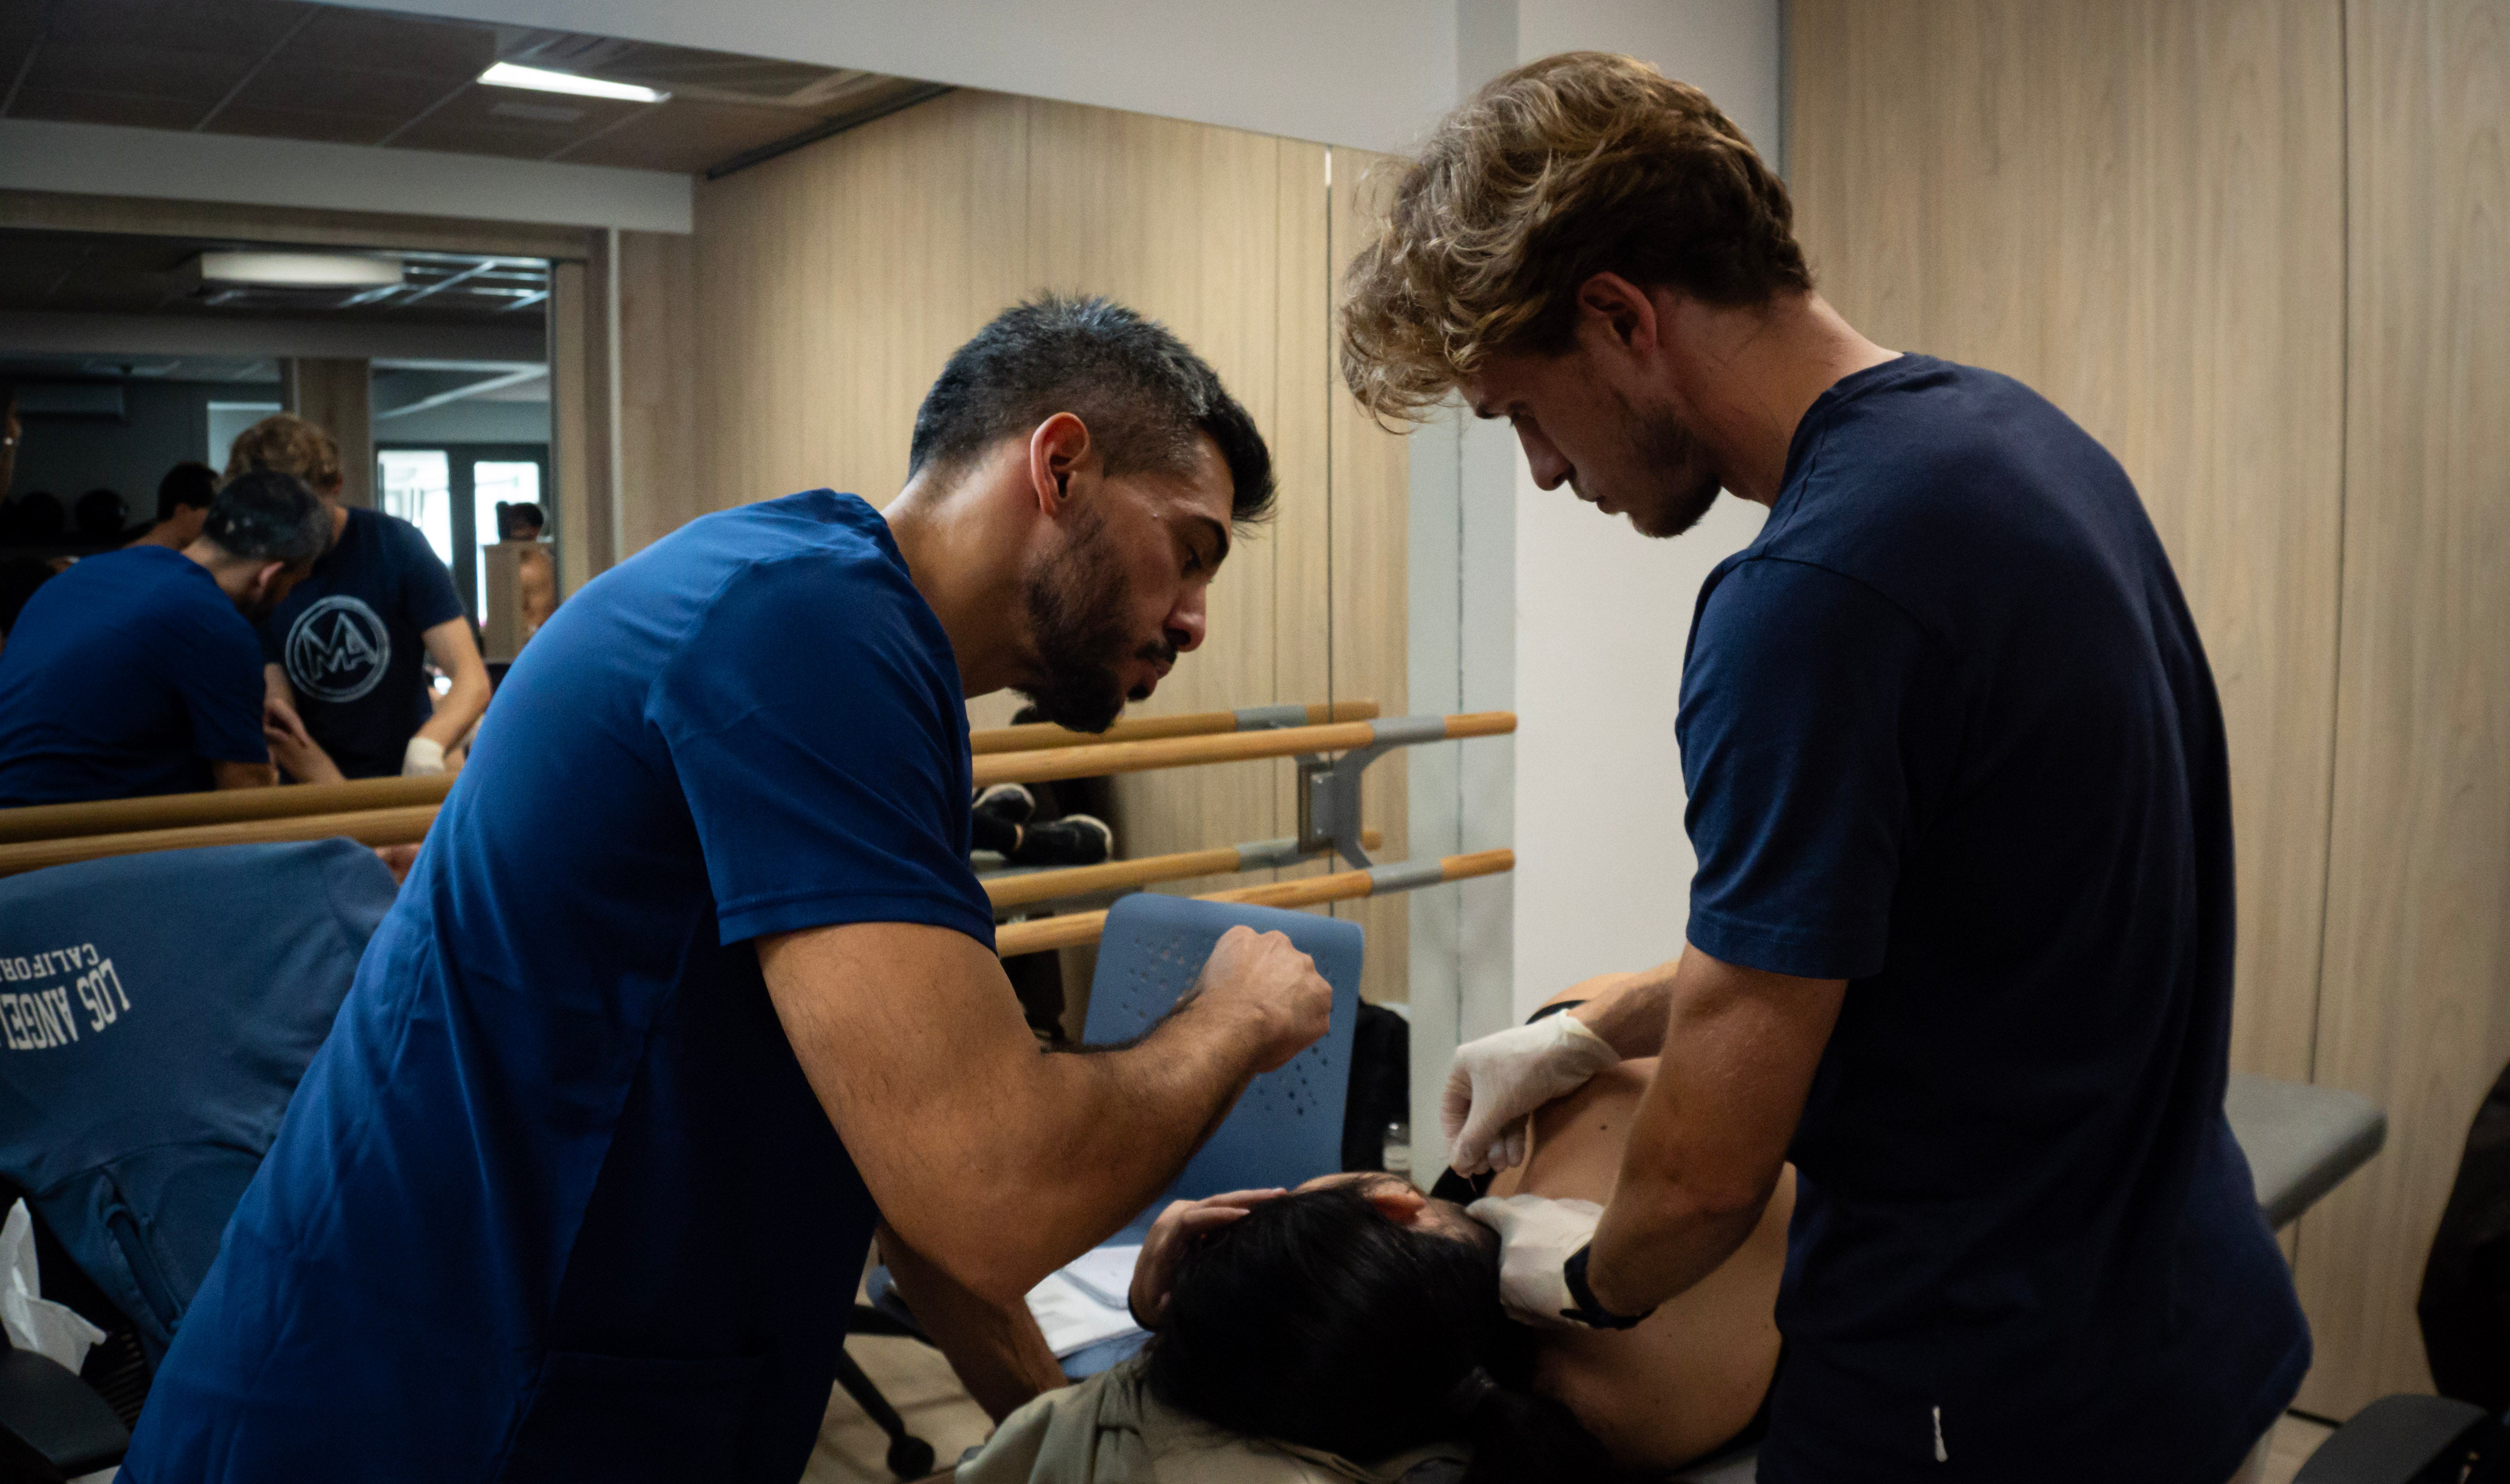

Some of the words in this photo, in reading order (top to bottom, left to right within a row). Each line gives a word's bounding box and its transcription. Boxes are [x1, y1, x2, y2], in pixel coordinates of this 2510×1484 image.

[0, 943, 99, 981] CALIFOR
[0, 986, 78, 1050] ANGEL
[77, 958, 131, 1032] LOS
